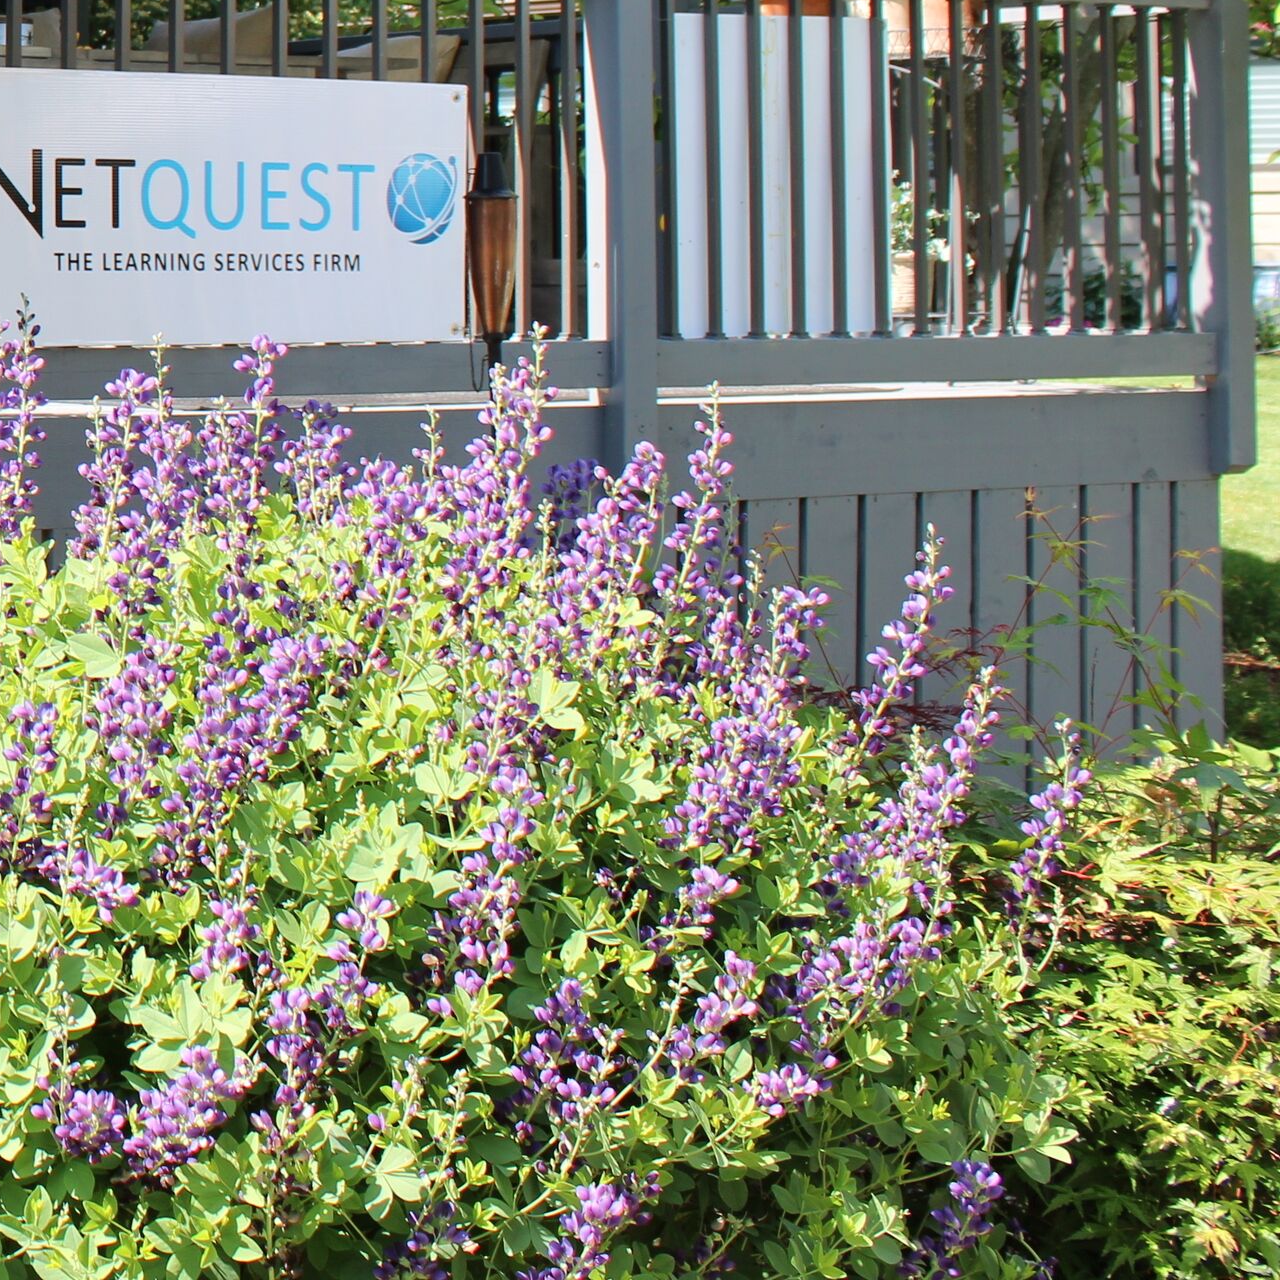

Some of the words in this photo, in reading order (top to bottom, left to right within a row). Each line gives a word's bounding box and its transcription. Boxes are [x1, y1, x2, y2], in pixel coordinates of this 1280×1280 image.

[54, 252, 93, 272] THE
[102, 252, 206, 272] LEARNING
[213, 252, 305, 273] SERVICES
[313, 253, 361, 273] FIRM
